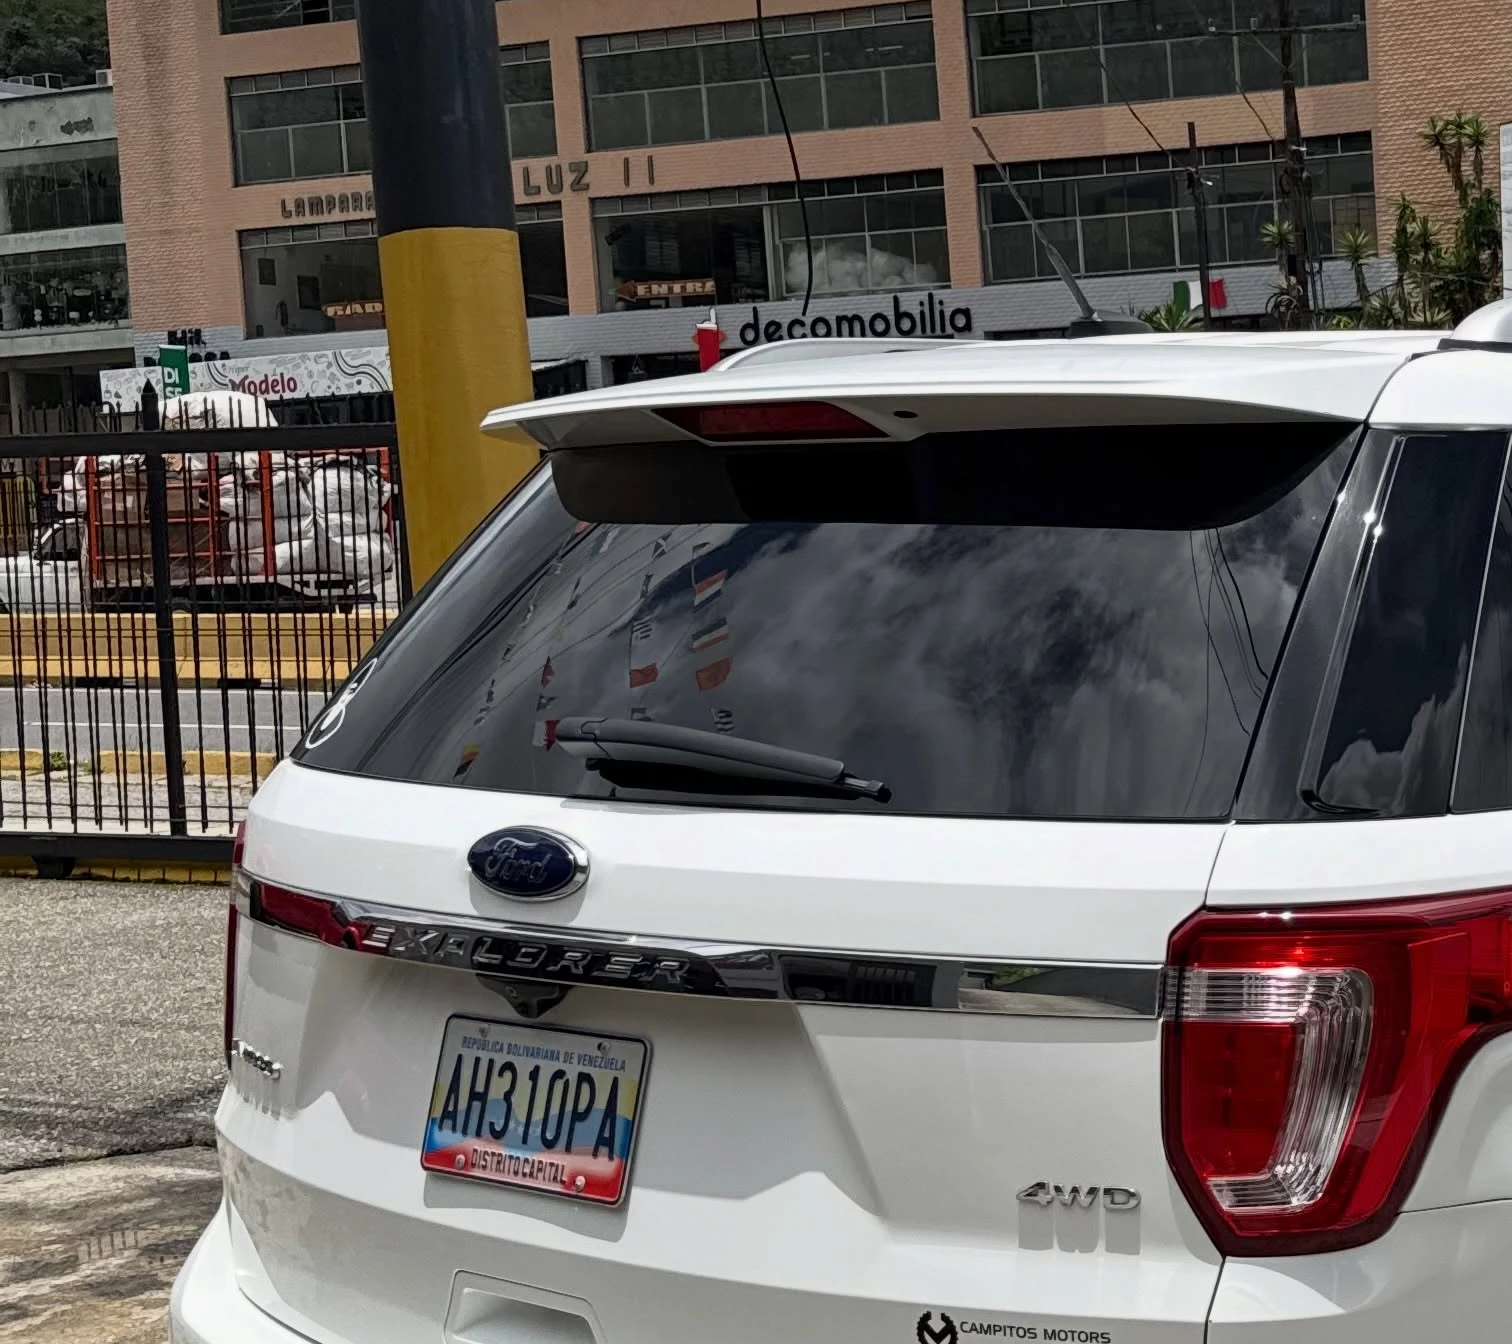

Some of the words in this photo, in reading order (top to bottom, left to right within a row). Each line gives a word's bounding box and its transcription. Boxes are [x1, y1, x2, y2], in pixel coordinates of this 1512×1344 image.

[522, 160, 590, 196] LUZ
[623, 155, 655, 188] II
[739, 292, 972, 346] decomobilia
[164, 367, 180, 384] DI
[229, 372, 298, 396] Modelo
[485, 837, 552, 883] Ford
[362, 924, 690, 986] EXPLORER
[506, 1043, 561, 1063] BOLIVARIANA
[563, 1051, 576, 1064] DE
[577, 1052, 627, 1072] VENEZUELA
[438, 1053, 620, 1162] AH310PA
[470, 1148, 521, 1176] DISTRITO
[521, 1156, 568, 1185] CAPITAL
[1015, 1181, 1142, 1210] 4WD
[959, 1321, 1038, 1340] CAMPITOS
[1043, 1328, 1112, 1344] MOTORS
